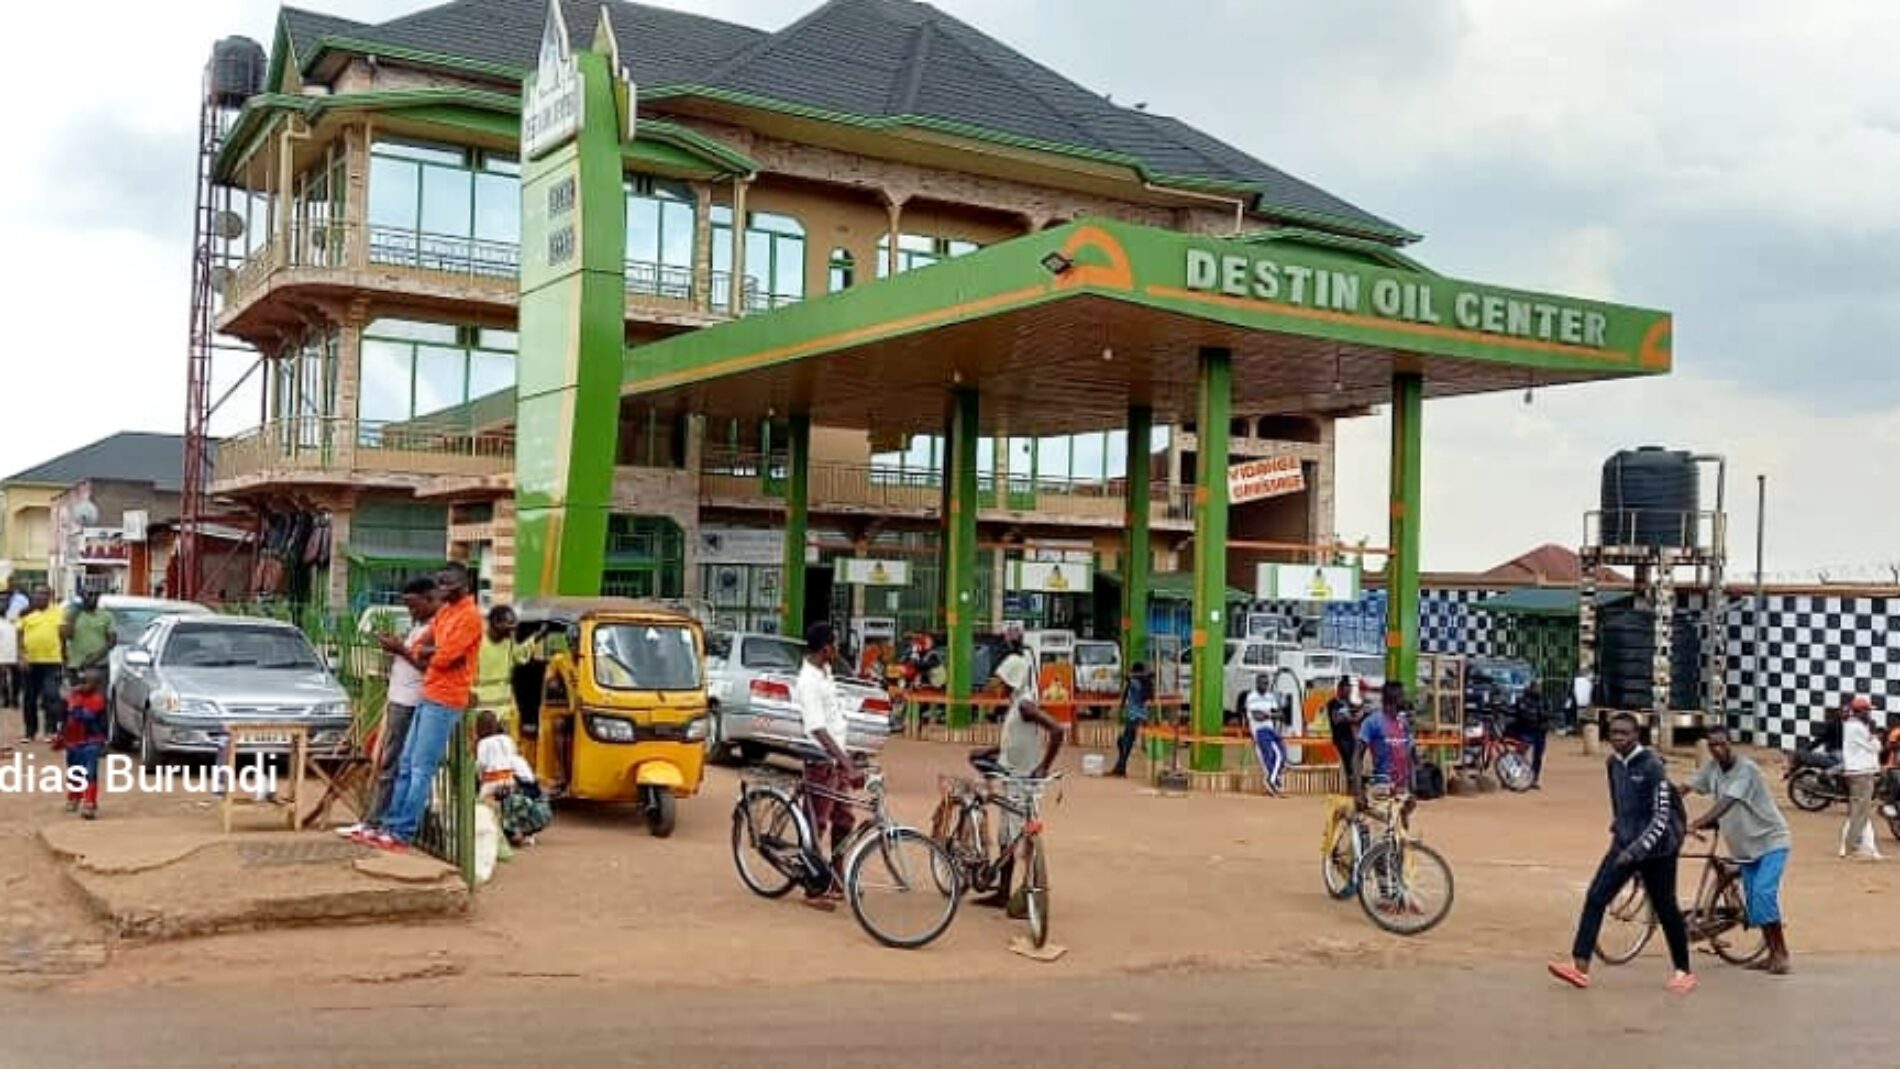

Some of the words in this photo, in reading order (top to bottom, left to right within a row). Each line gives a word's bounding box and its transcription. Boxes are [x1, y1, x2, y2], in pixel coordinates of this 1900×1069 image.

[1186, 248, 1360, 312] DESTIN
[1373, 278, 1439, 324] OIL
[1456, 292, 1607, 346] CENTER
